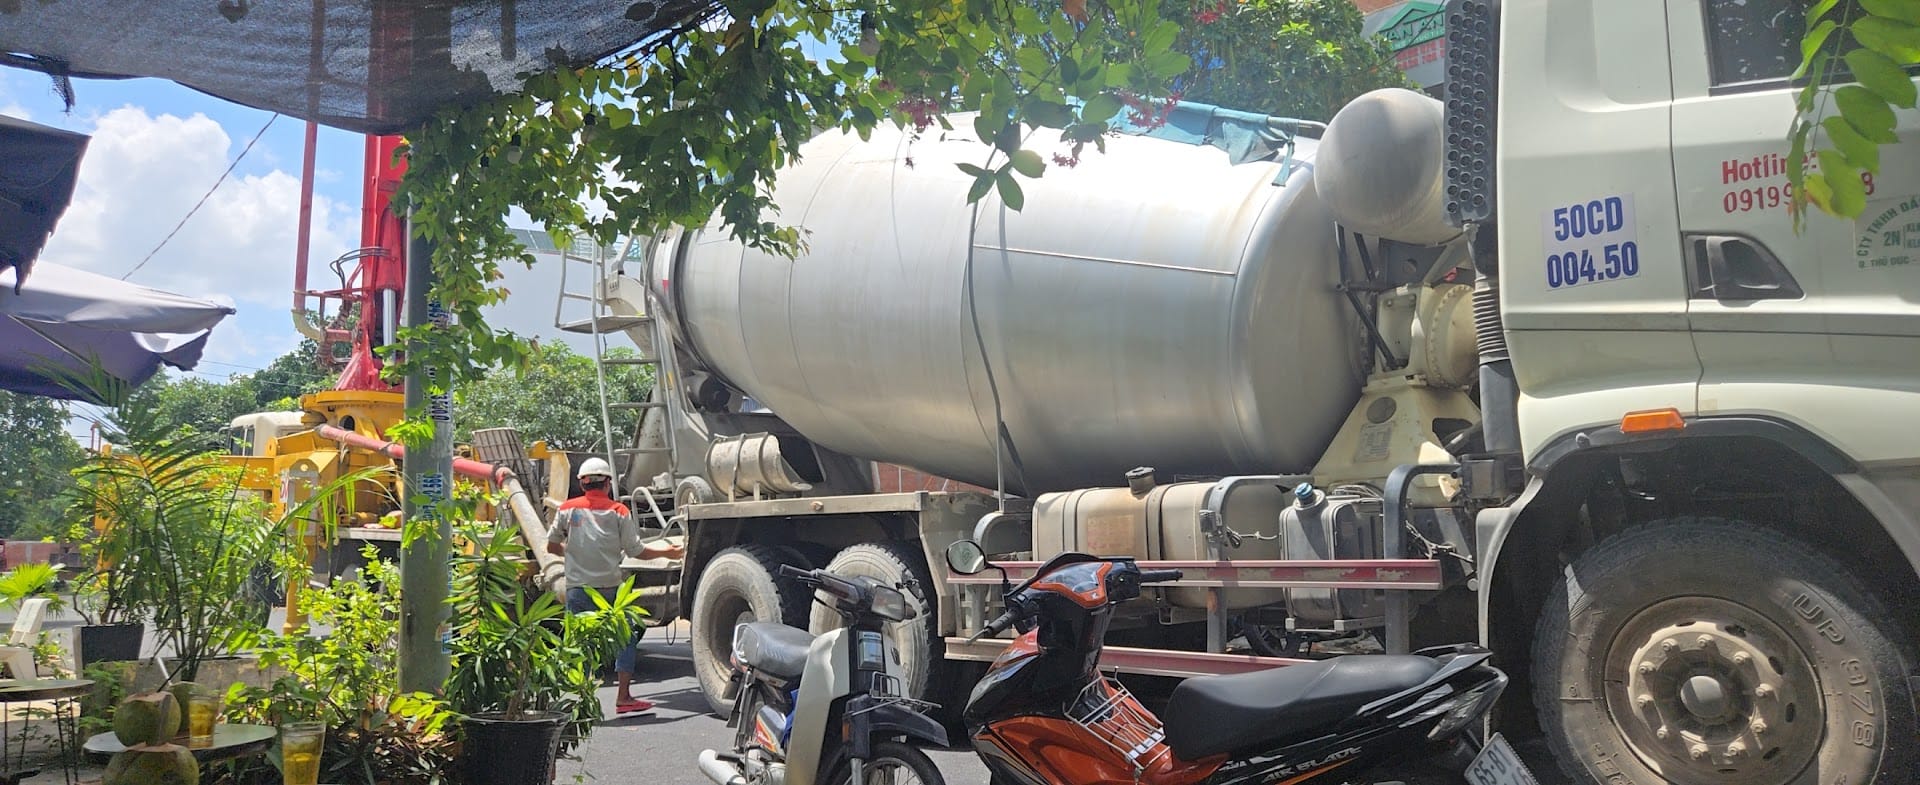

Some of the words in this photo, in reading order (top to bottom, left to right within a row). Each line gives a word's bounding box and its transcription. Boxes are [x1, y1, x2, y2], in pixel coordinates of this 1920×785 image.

[1554, 196, 1623, 241] 50CD
[1547, 241, 1638, 288] 004.50
[1262, 766, 1296, 784] AIR
